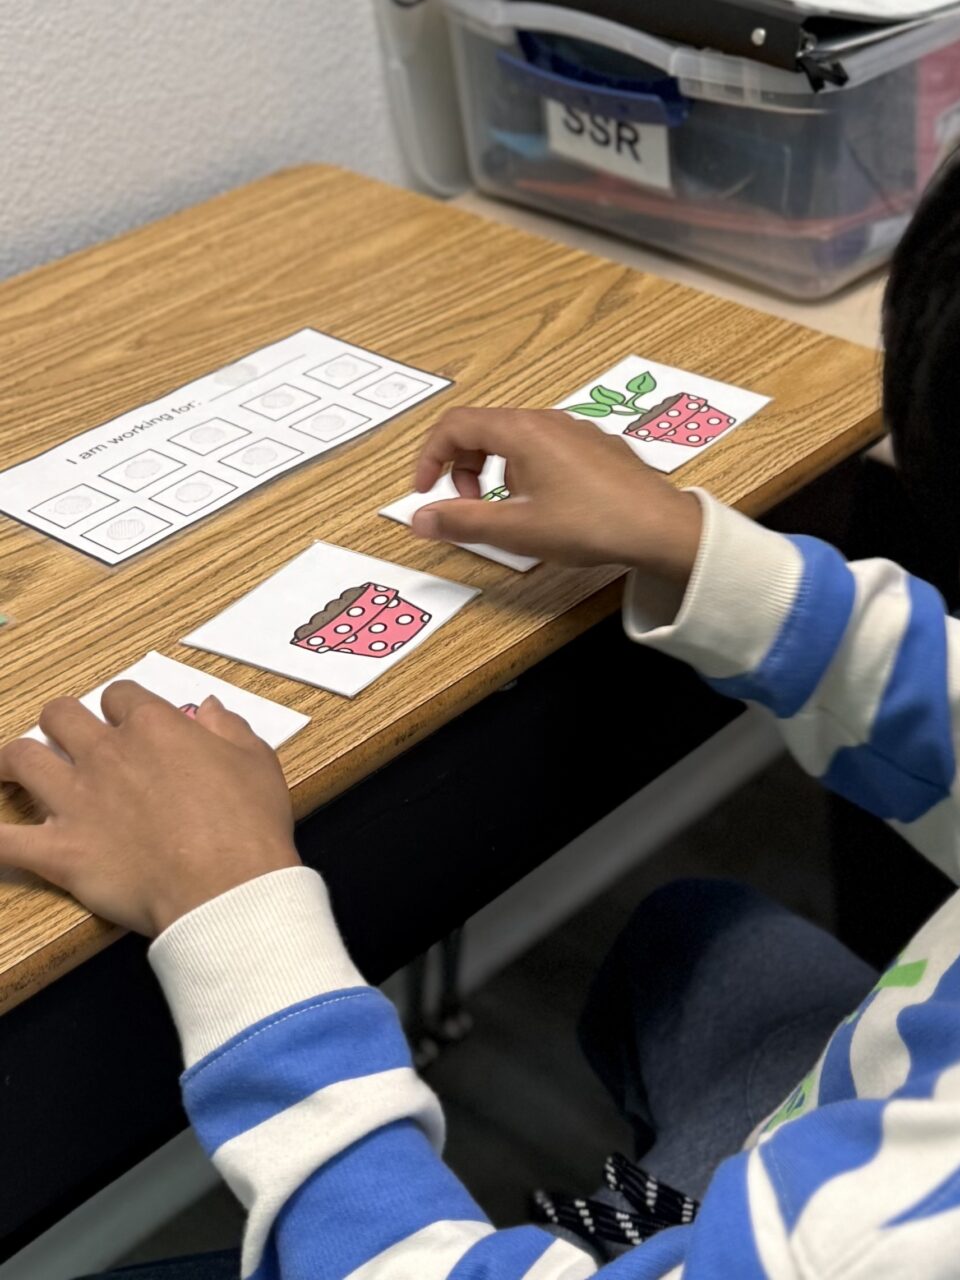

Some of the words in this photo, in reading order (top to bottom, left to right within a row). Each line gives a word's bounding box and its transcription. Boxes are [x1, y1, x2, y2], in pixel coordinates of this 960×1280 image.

[562, 105, 642, 163] SSR
[65, 457, 78, 465] I
[79, 443, 108, 460] am
[107, 412, 175, 445] working
